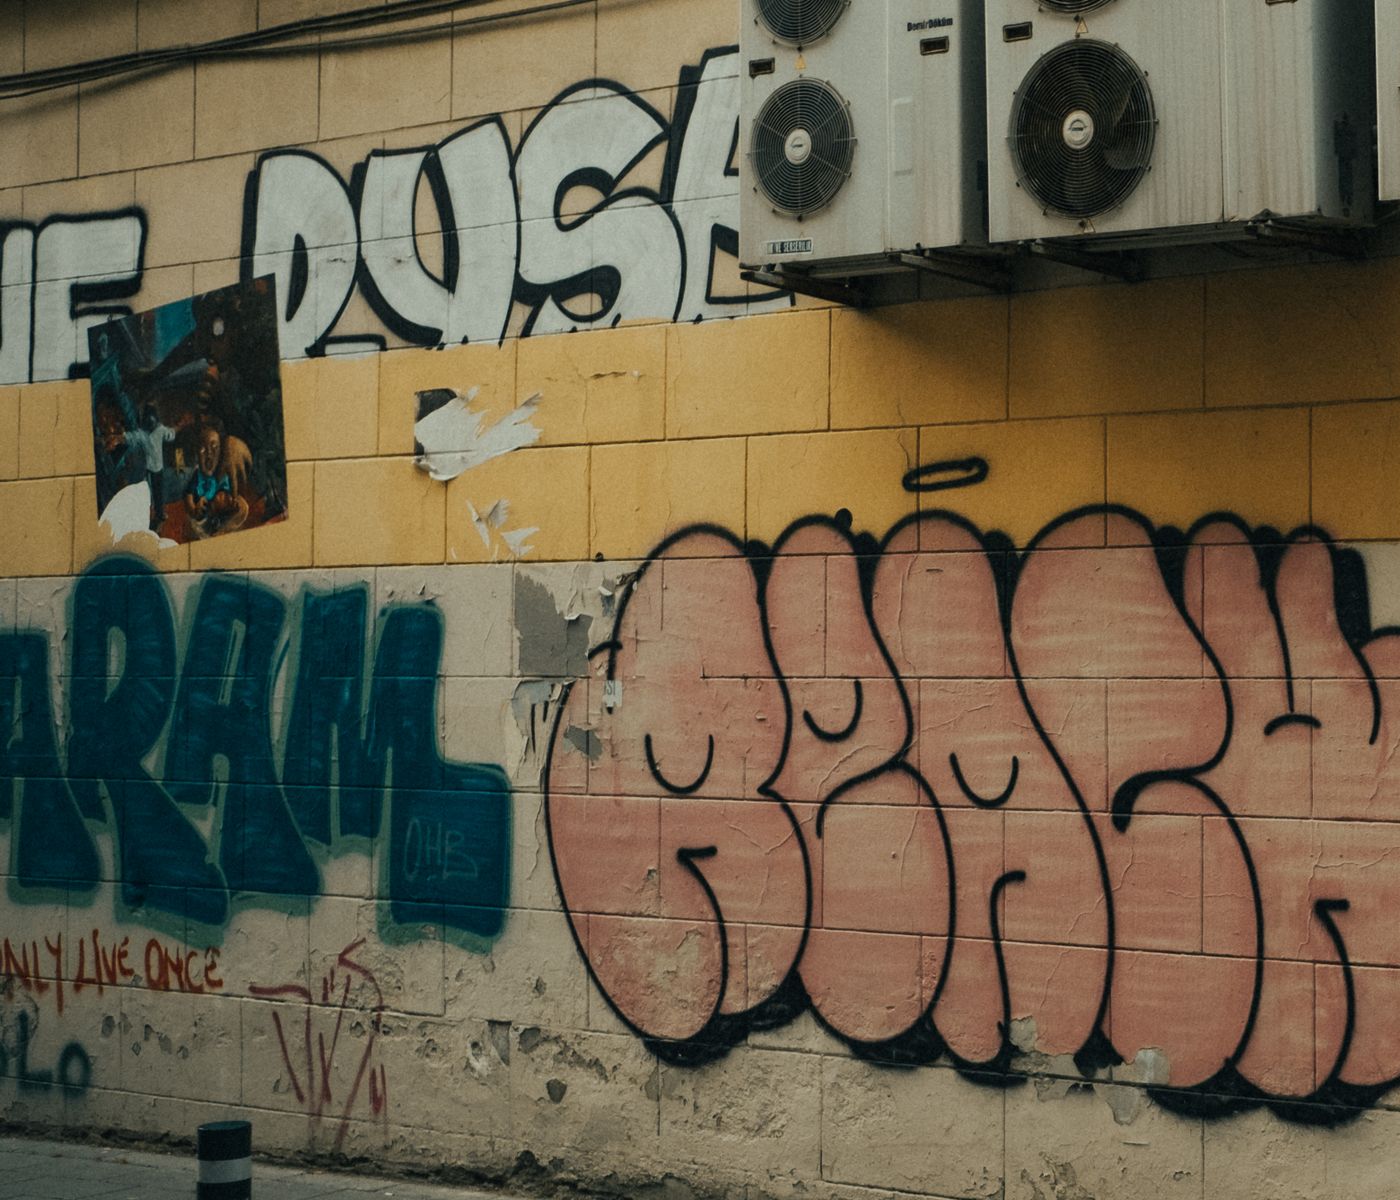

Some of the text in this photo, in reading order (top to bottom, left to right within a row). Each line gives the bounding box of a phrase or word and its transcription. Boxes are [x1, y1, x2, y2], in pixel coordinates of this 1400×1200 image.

[0, 929, 224, 1017] NLY LIVE ONCE
